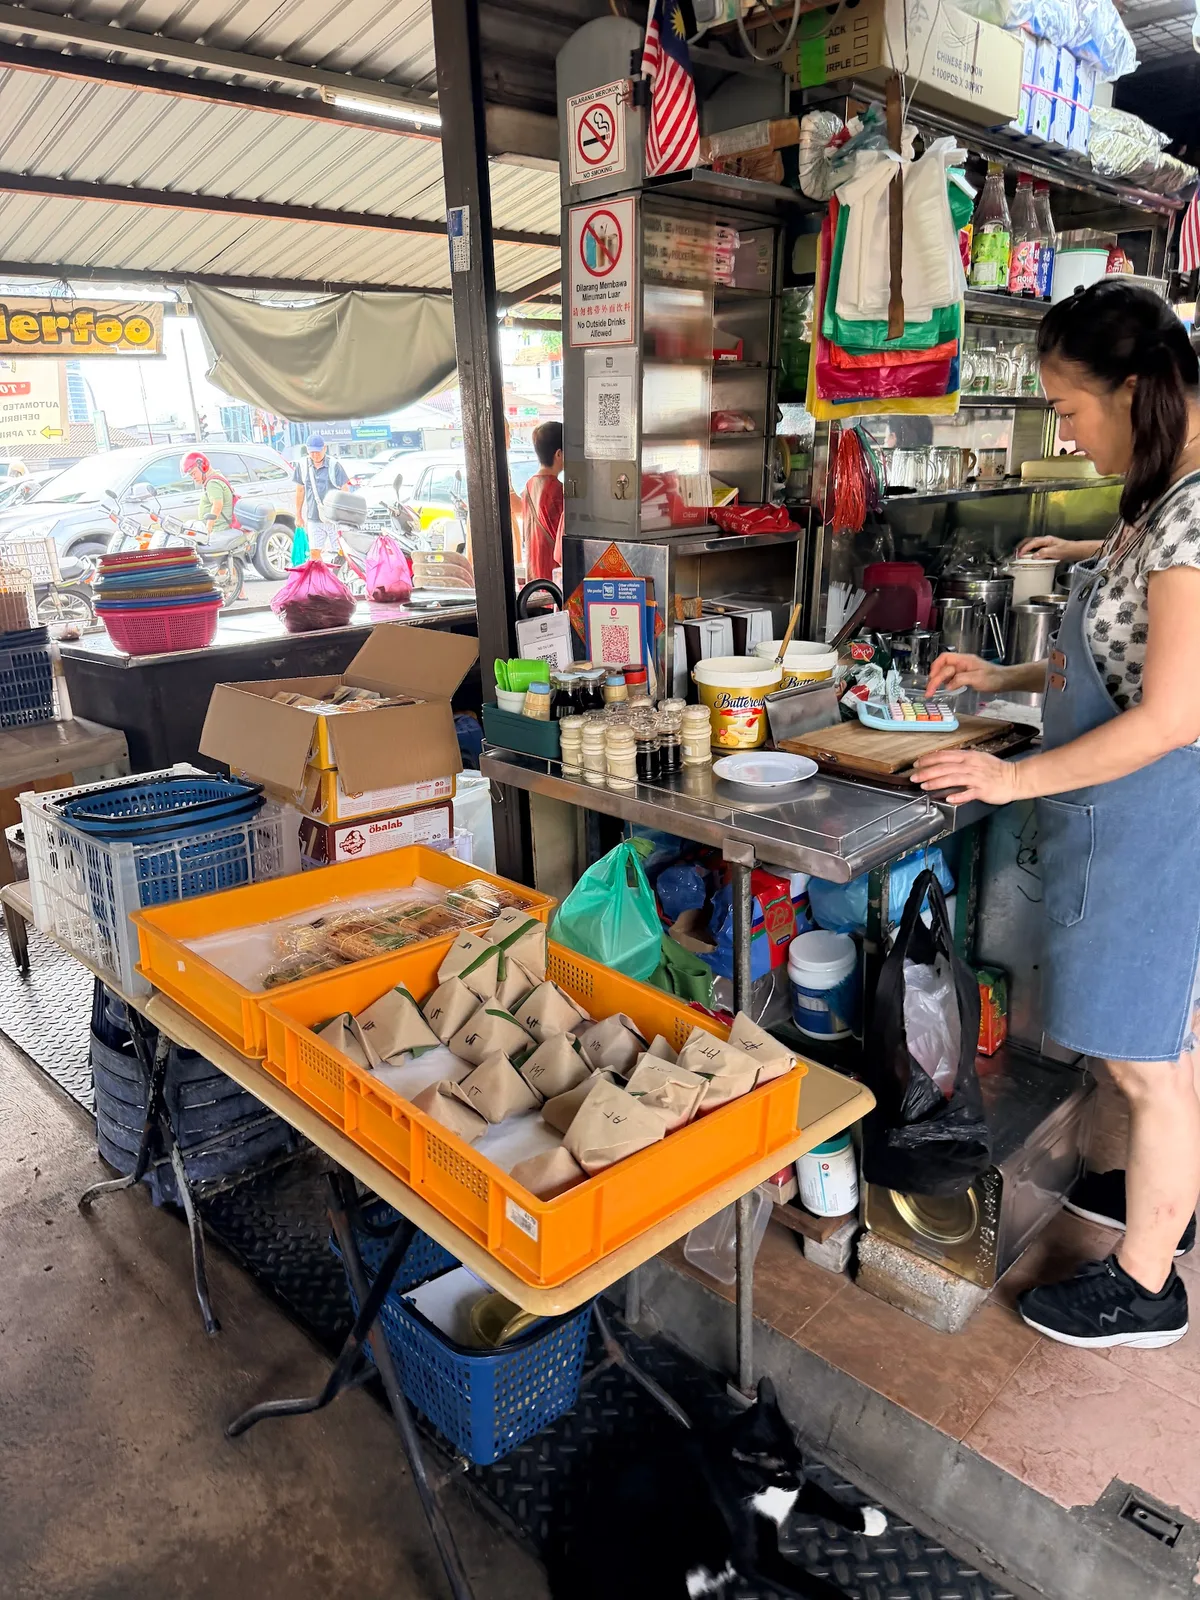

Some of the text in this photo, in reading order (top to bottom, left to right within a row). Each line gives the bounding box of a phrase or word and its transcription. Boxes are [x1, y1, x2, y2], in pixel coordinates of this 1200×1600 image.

[825, 25, 847, 39] ACK
[936, 51, 983, 77] CHINESE SPOON
[571, 85, 620, 106] DILARANG MEROKOK
[591, 166, 612, 176] SMOKING
[576, 280, 628, 293] Dilarang Membawa
[582, 291, 621, 301] Minuman Luar
[577, 318, 626, 329] No Outside Drinks
[590, 329, 612, 338] Allowed
[368, 819, 403, 834] öbalab
